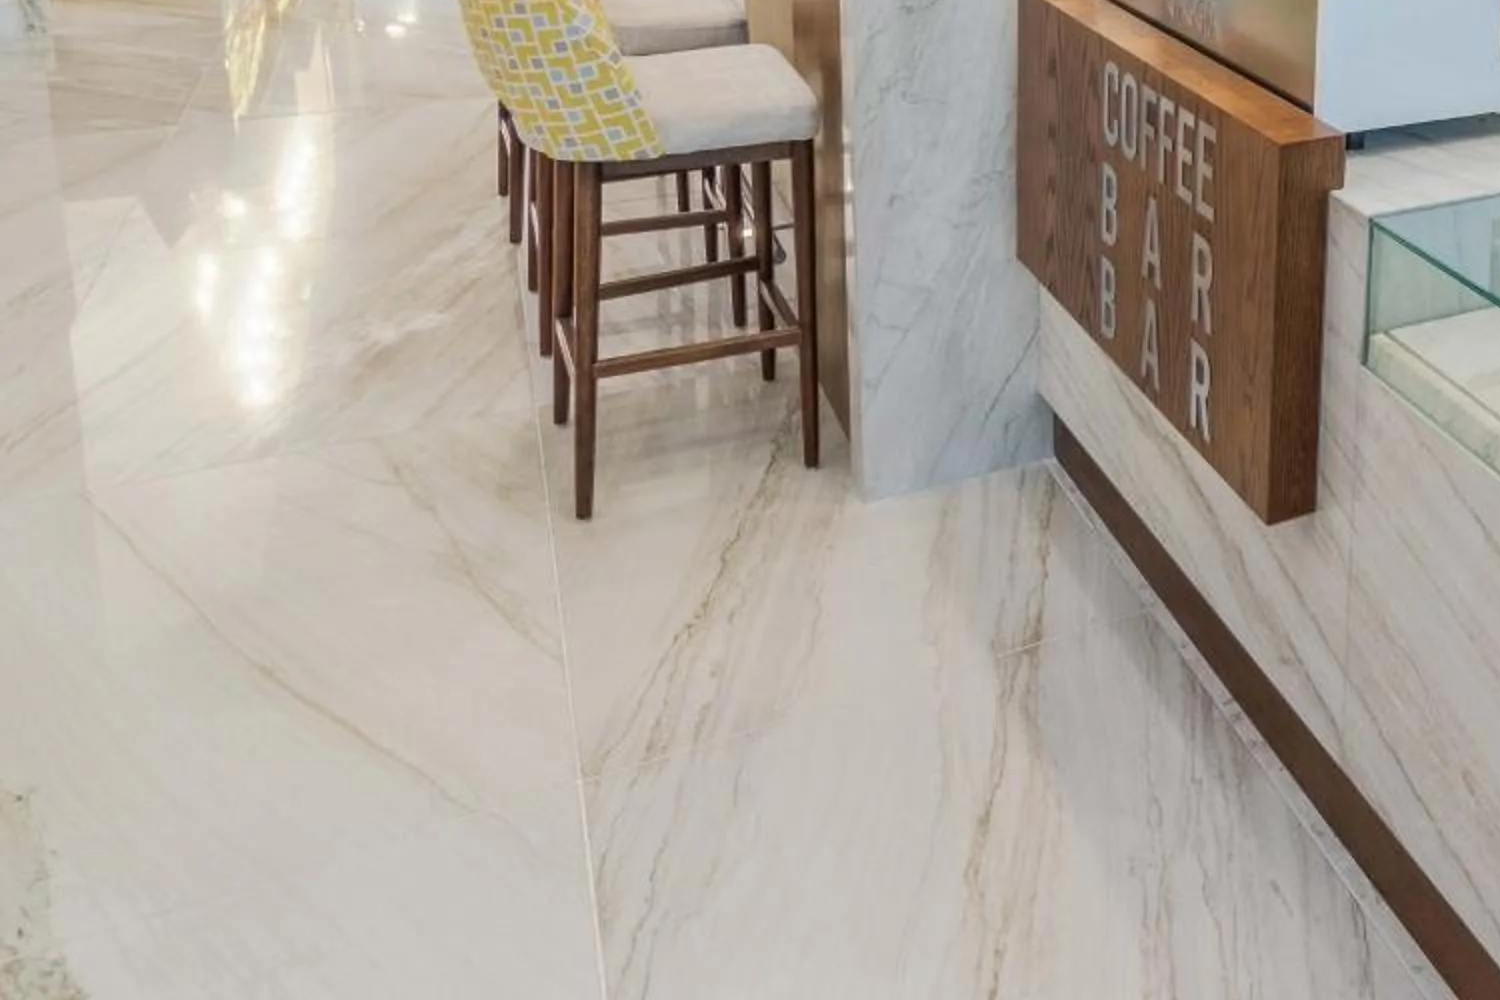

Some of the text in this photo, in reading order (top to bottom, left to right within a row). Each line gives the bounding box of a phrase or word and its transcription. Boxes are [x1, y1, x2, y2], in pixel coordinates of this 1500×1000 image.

[1103, 61, 1217, 224] COFFEE
[1101, 161, 1213, 336] BAR
[1100, 254, 1212, 445] BAR
